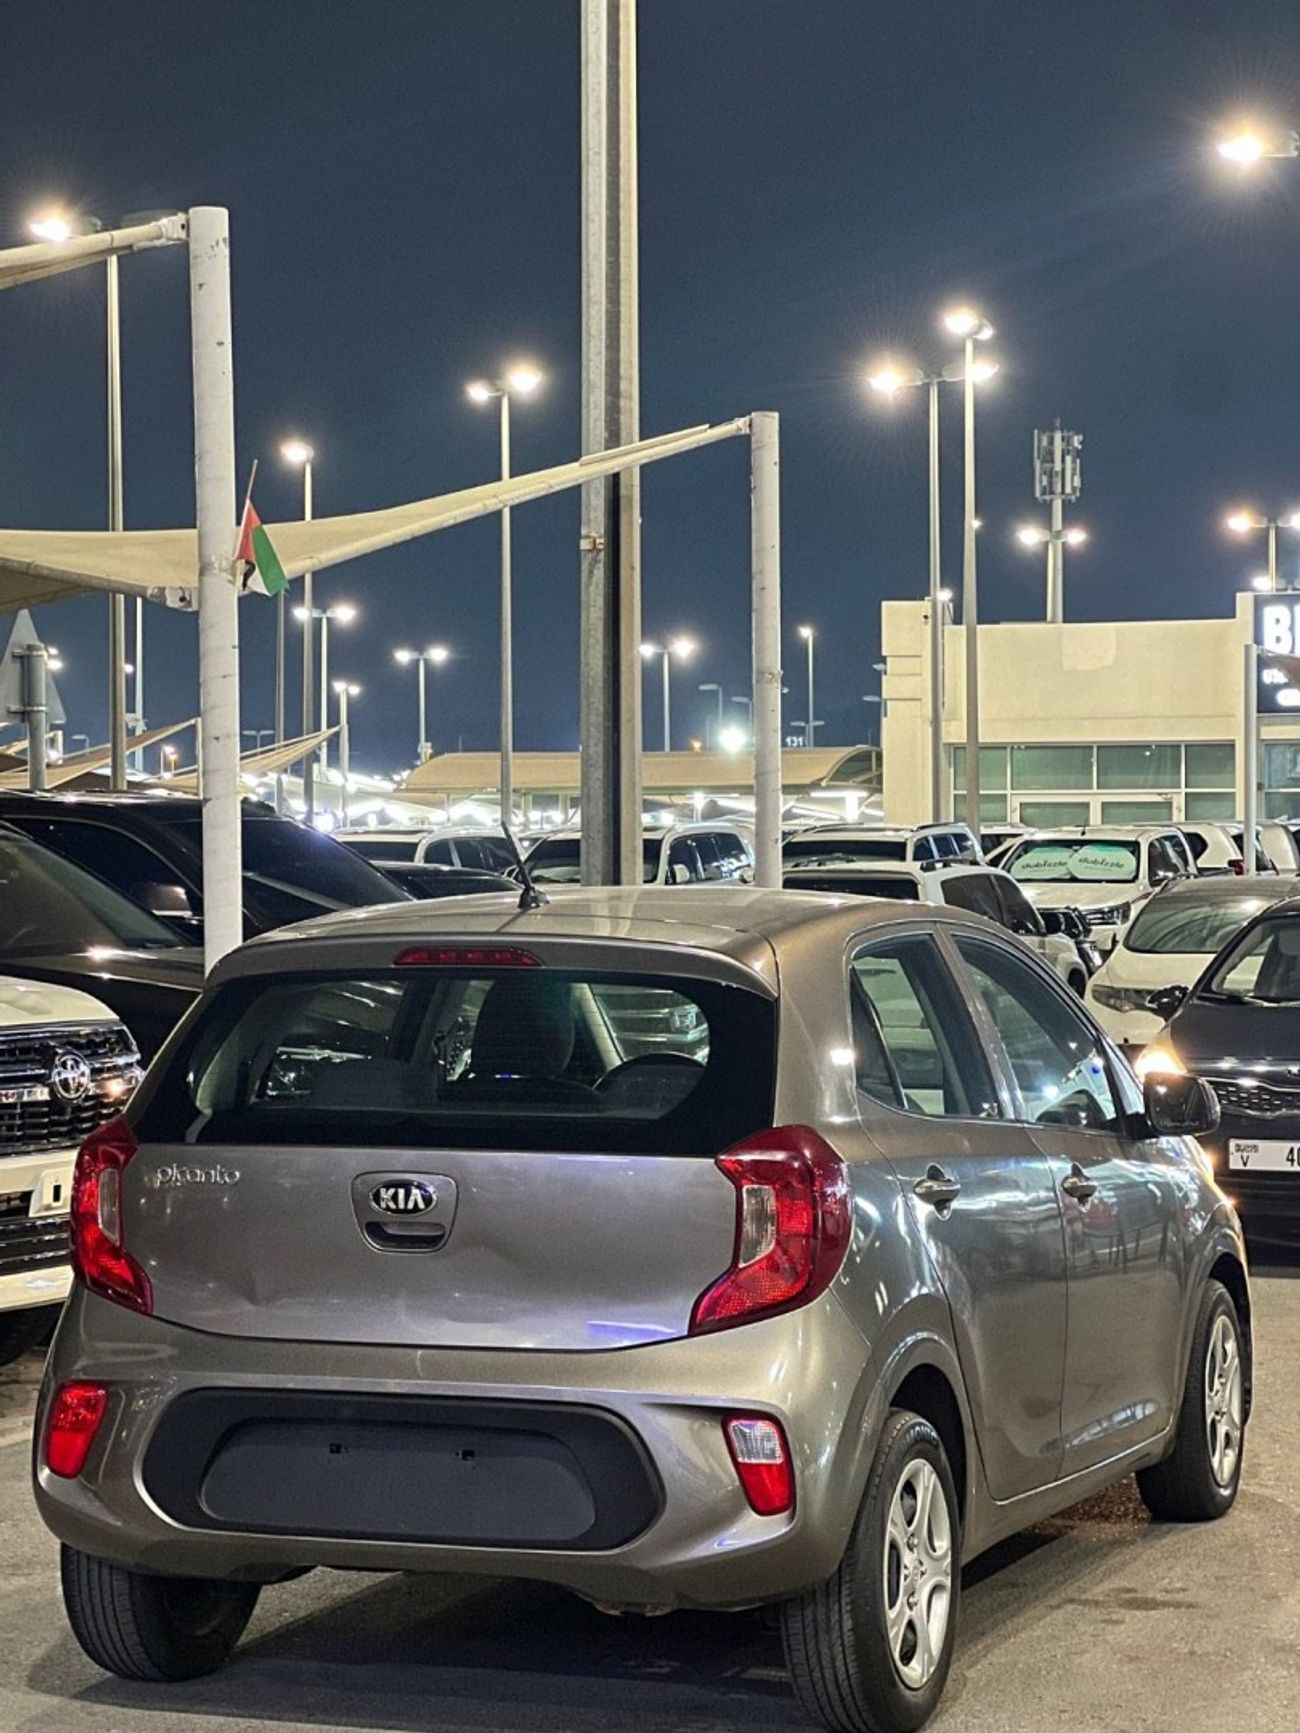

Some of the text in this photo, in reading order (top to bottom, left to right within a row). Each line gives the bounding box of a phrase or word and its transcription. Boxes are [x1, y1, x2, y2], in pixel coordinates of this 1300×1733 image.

[1263, 605, 1300, 654] B
[1241, 1154, 1250, 1168] V
[157, 1164, 240, 1187] picanto
[380, 1186, 425, 1209] KIA
